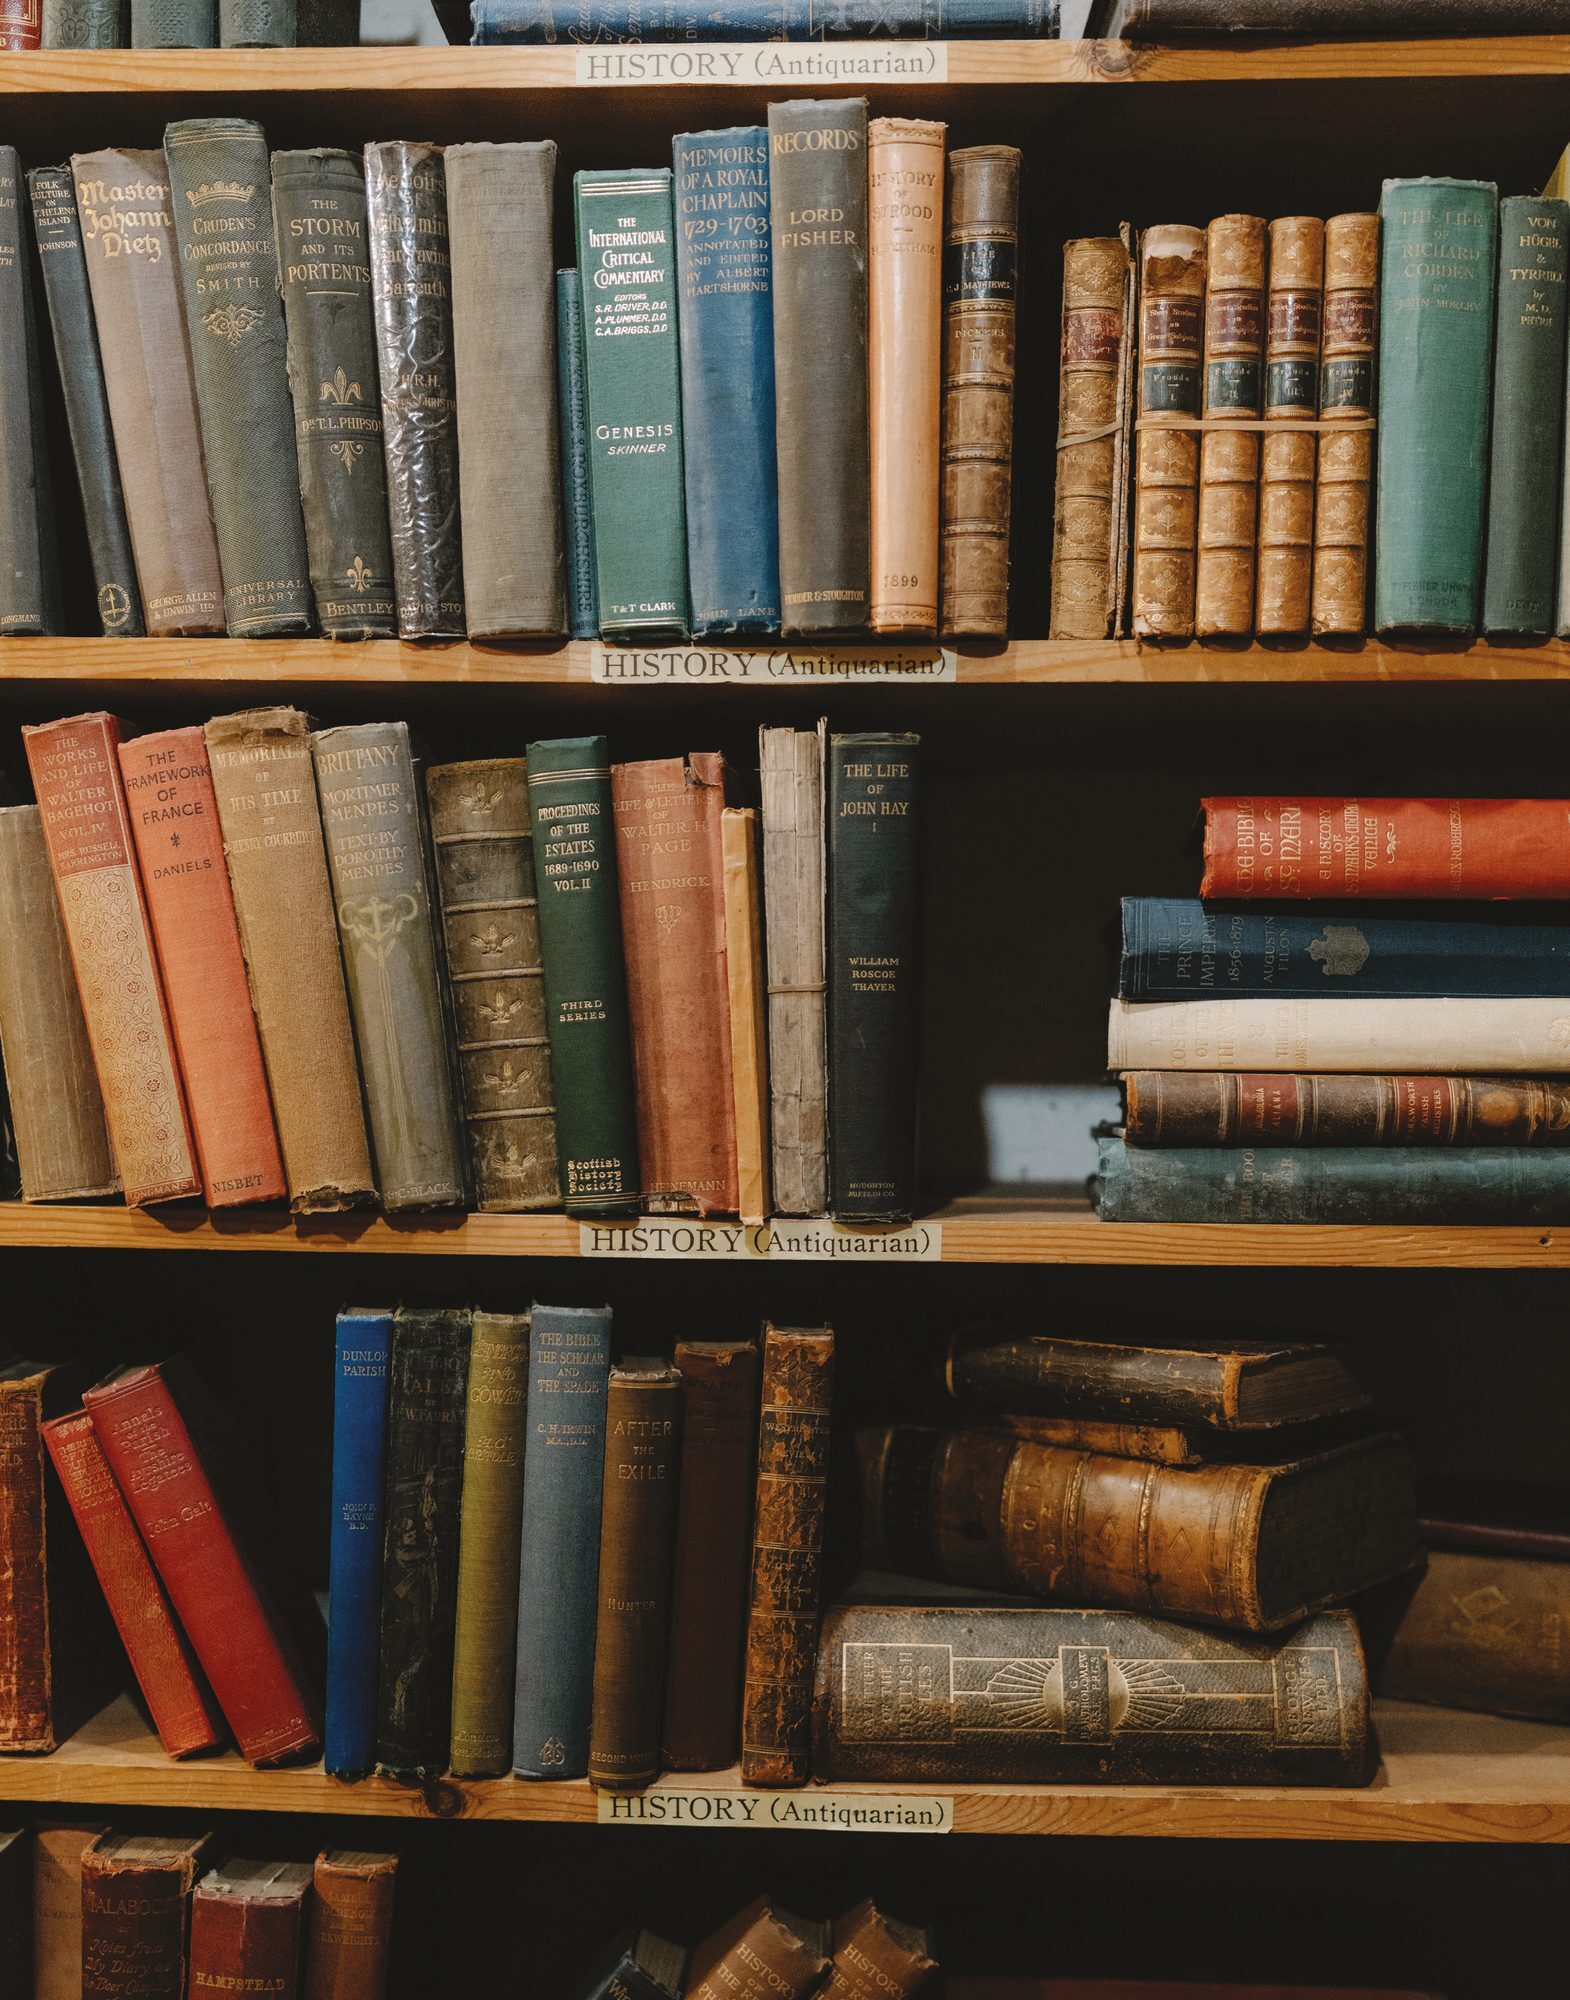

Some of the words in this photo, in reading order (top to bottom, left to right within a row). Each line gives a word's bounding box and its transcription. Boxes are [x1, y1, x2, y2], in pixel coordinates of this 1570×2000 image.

[587, 52, 744, 80] HISTORY
[754, 47, 936, 80] (Antiquarian)
[773, 129, 858, 155] RECORDS
[681, 147, 767, 168] MEMOIRS
[36, 182, 60, 191] FOLK
[682, 177, 700, 191] OF
[702, 175, 714, 189] A
[717, 169, 768, 188] ROYAL
[31, 190, 71, 200] CULTURE
[80, 180, 169, 206] Master
[682, 190, 768, 214] CHAPLAIN
[312, 199, 338, 210] THE
[38, 216, 70, 226] ISLAND
[84, 207, 172, 239] Johann
[617, 218, 637, 228] THE
[790, 208, 844, 226] LORD
[1527, 216, 1557, 230] VON
[193, 218, 256, 236] CRUDEN'S
[290, 218, 361, 239] STORM
[684, 213, 769, 241] 1729-1763
[1433, 229, 1450, 240] OF
[39, 240, 77, 253] JOHNSON
[588, 229, 667, 249] INTERNATIONAL
[682, 240, 769, 254] ANNOTATED
[780, 231, 858, 250] FISHER
[184, 240, 271, 262] CONCORDANCE
[301, 245, 325, 256] AND
[333, 244, 355, 256] ITS
[1402, 243, 1481, 262] RICHARD
[602, 250, 655, 269] CRITICAL
[688, 257, 711, 268] AND
[720, 253, 769, 265] EDITED
[1536, 254, 1546, 265] &
[288, 263, 371, 285] PORTENTS
[593, 269, 666, 289] COMMENTARY
[687, 271, 700, 283] BY
[717, 266, 769, 279] ALBERT
[1404, 262, 1475, 281] COBDEN
[1509, 268, 1565, 284] TYRRELL
[687, 281, 769, 297] HARTSHORNE
[1434, 283, 1448, 293] BY
[1533, 289, 1545, 301] by
[614, 293, 647, 302] EDITORS
[595, 424, 674, 440] GENESIS
[608, 443, 667, 456] SKINNER
[230, 580, 304, 595] UNIVERSAL
[884, 575, 919, 588] 1899
[150, 598, 185, 610] GEORGE
[186, 592, 217, 605] ALLEN
[236, 592, 297, 607] LIBRARY
[823, 589, 865, 604] STOUGHTON
[326, 601, 393, 617] BENTLEY
[640, 601, 676, 612] CLARK
[697, 609, 729, 620] JOHN
[738, 606, 776, 617] LANE
[602, 651, 756, 679] HISTORY
[767, 650, 946, 683] (Antiquarian)
[54, 736, 81, 752] THE
[42, 747, 98, 768] WORKS
[146, 750, 177, 768] THE
[317, 745, 400, 777] BRITTANY
[40, 769, 70, 785] AND
[73, 760, 108, 777] LIFE
[126, 763, 212, 793] FRAMEWORK
[255, 771, 272, 784] OF
[843, 764, 872, 778] THE
[876, 764, 909, 778] LIFE
[65, 779, 83, 790] OF
[322, 781, 403, 806] MORTIMER
[650, 781, 675, 793] THE
[866, 784, 884, 795] OF
[46, 787, 107, 808] WALTER
[156, 786, 178, 803] OF
[231, 794, 258, 813] HIS
[261, 788, 301, 807] TIME
[46, 801, 115, 825] BAGEHOT
[142, 801, 204, 827] FRANCE
[331, 799, 401, 823] MENPES
[538, 803, 601, 822] PROCEEDINGS
[613, 799, 641, 813] LIFE
[840, 802, 877, 817] JOHN
[880, 802, 909, 816] HAY
[651, 810, 668, 821] OF
[550, 826, 567, 837] OF
[569, 822, 591, 835] THE
[621, 820, 691, 839] WALTER
[1318, 807, 1333, 866] HISTORY
[81, 840, 122, 857] RUSSELL
[544, 840, 596, 858] ESTATES
[640, 838, 692, 857] PAGE
[1258, 831, 1273, 856] OF
[1333, 834, 1344, 853] OF
[1364, 816, 1378, 871] VENICE
[59, 853, 123, 873] BARRINGTON
[334, 846, 408, 868] DOROTHY
[153, 858, 213, 881] DANIELS
[341, 860, 405, 882] MENPES
[544, 860, 600, 878] 1689-1690
[631, 876, 712, 894] HENDRICK
[1177, 911, 1194, 980] PRINCE
[1200, 914, 1216, 987] IMPERIAL
[1227, 915, 1245, 983] 1856-1879
[1263, 915, 1277, 983] AUGUSTIN
[1277, 927, 1292, 972] FILON
[849, 956, 899, 967] WILLIAM
[851, 968, 896, 979] ROSCOE
[852, 981, 896, 992] THAYER
[560, 999, 604, 1011] THIRD
[559, 1010, 606, 1023] SERIES
[567, 1156, 622, 1171] Scottish
[212, 1174, 264, 1194] NISBET
[567, 1169, 623, 1183] History
[129, 1182, 190, 1200] LONGMANS
[567, 1181, 623, 1195] Society
[651, 1180, 727, 1193] HEINEMANN
[591, 1227, 745, 1254] HISTORY
[753, 1227, 931, 1257] (Antiquarian)
[539, 1332, 563, 1346] THE
[565, 1333, 601, 1347] BIBLE
[342, 1350, 389, 1363] DUNLOP
[536, 1351, 558, 1364] THE
[559, 1351, 605, 1365] SCHOLAR
[343, 1365, 388, 1377] PARISH
[557, 1366, 580, 1378] AND
[537, 1379, 560, 1393] THE
[563, 1380, 600, 1395] SPADE
[112, 1405, 164, 1437] Annals
[562, 1424, 597, 1435] IRWIN
[613, 1420, 673, 1437] AFTER
[119, 1427, 173, 1456] Parish
[632, 1445, 656, 1455] THE
[618, 1463, 668, 1481] EXILE
[342, 1503, 371, 1513] JOHN
[342, 1511, 375, 1522] BAYNE
[146, 1514, 182, 1540] John
[178, 1499, 214, 1523] Galt
[349, 1521, 370, 1531] B.D.
[608, 1597, 657, 1612] HUNTER
[880, 1665, 894, 1698] THE
[898, 1650, 914, 1739] BRITISH
[918, 1665, 934, 1726] ISLES
[1078, 1651, 1091, 1740] BARTHOLOMEW
[1284, 1655, 1298, 1741] GEORGE
[1299, 1654, 1315, 1738] NEWNES
[880, 1699, 894, 1724] OF
[591, 1751, 627, 1763] SECOND
[609, 1795, 760, 1823] HISTORY
[768, 1796, 944, 1828] (Antiquarian)
[194, 1970, 287, 1992] HAMPSTEAD
